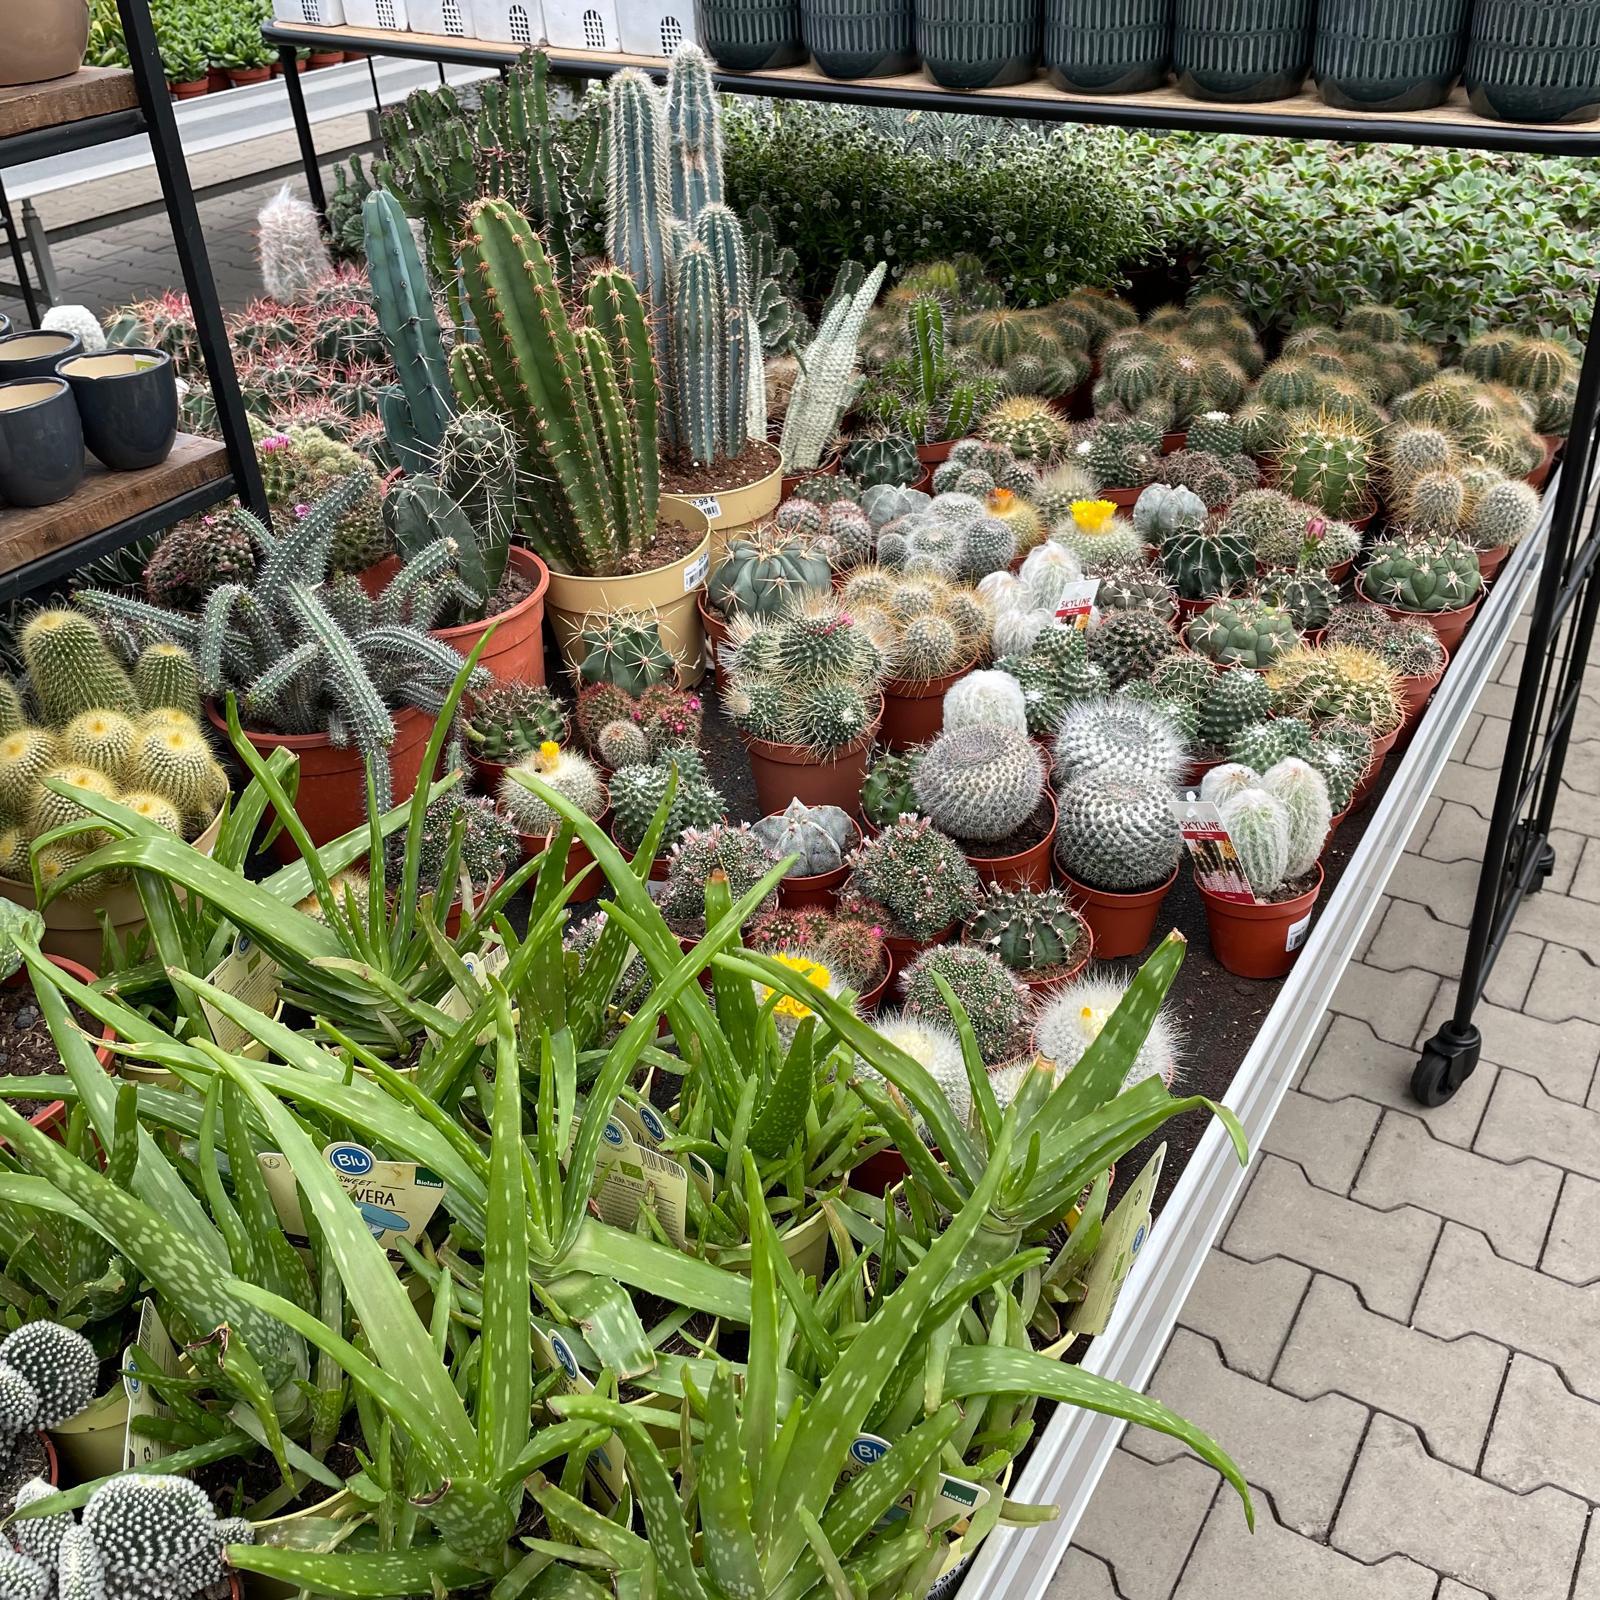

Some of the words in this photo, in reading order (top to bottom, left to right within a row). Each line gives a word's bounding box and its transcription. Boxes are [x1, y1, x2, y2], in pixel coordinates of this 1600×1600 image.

[1061, 597, 1091, 608] SKYLINE
[1181, 821, 1222, 832] SKYLINE
[337, 1153, 367, 1167] Blu
[416, 1179, 443, 1188] Bioland
[355, 1188, 396, 1207] VERA
[942, 1490, 973, 1506] Bioland
